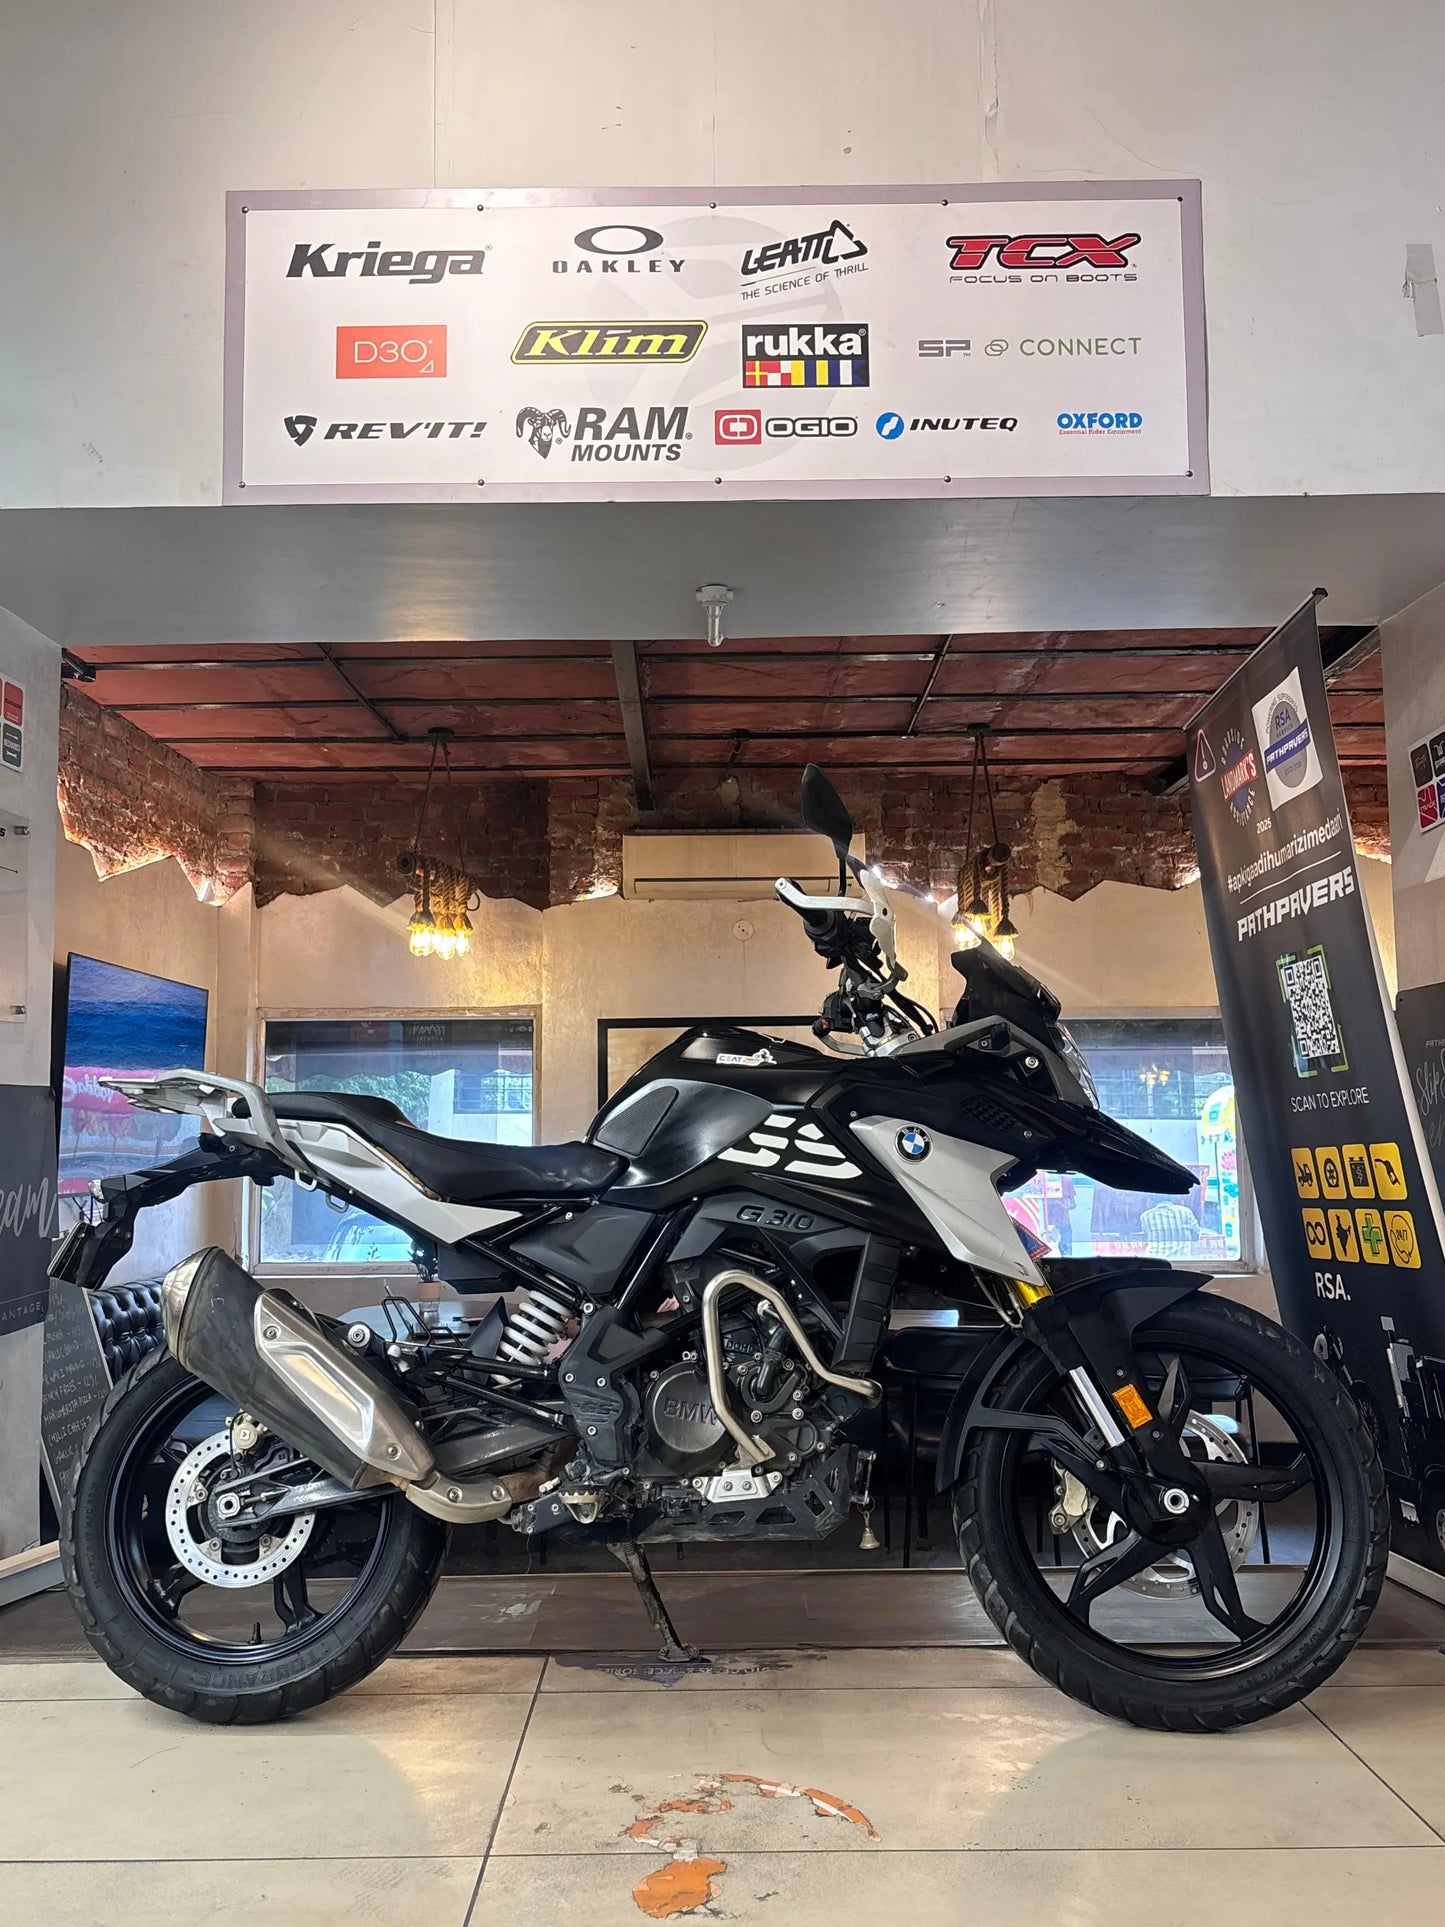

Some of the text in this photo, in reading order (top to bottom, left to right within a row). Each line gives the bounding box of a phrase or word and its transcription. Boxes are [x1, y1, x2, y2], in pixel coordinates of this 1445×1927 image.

[286, 241, 486, 284] Kriega
[946, 233, 1141, 270] TCX
[553, 259, 686, 273] OAKLEY
[949, 274, 1023, 284] FOCUS
[1065, 273, 1138, 282] BOOTS
[741, 263, 869, 301] THE SCIENCE OF THRILL
[524, 329, 688, 356] Klim
[747, 326, 862, 356] rukka
[1019, 337, 1142, 356] CONNECT
[324, 421, 488, 439] REV'IT!
[573, 407, 689, 441] RAM
[765, 417, 858, 437] OGIO
[909, 416, 1018, 432] INUTEQ
[1056, 412, 1143, 429] OXFORD
[571, 443, 682, 462] MOUNTS
[1275, 708, 1291, 730] RSA
[1256, 817, 1272, 834] 2025
[1237, 865, 1355, 942] PATHPAVERS
[1291, 1087, 1370, 1113] SCAN TO EXPLORE
[736, 1205, 816, 1230] G 310
[1315, 1272, 1352, 1301] RSA.
[664, 1399, 718, 1426] BMW
